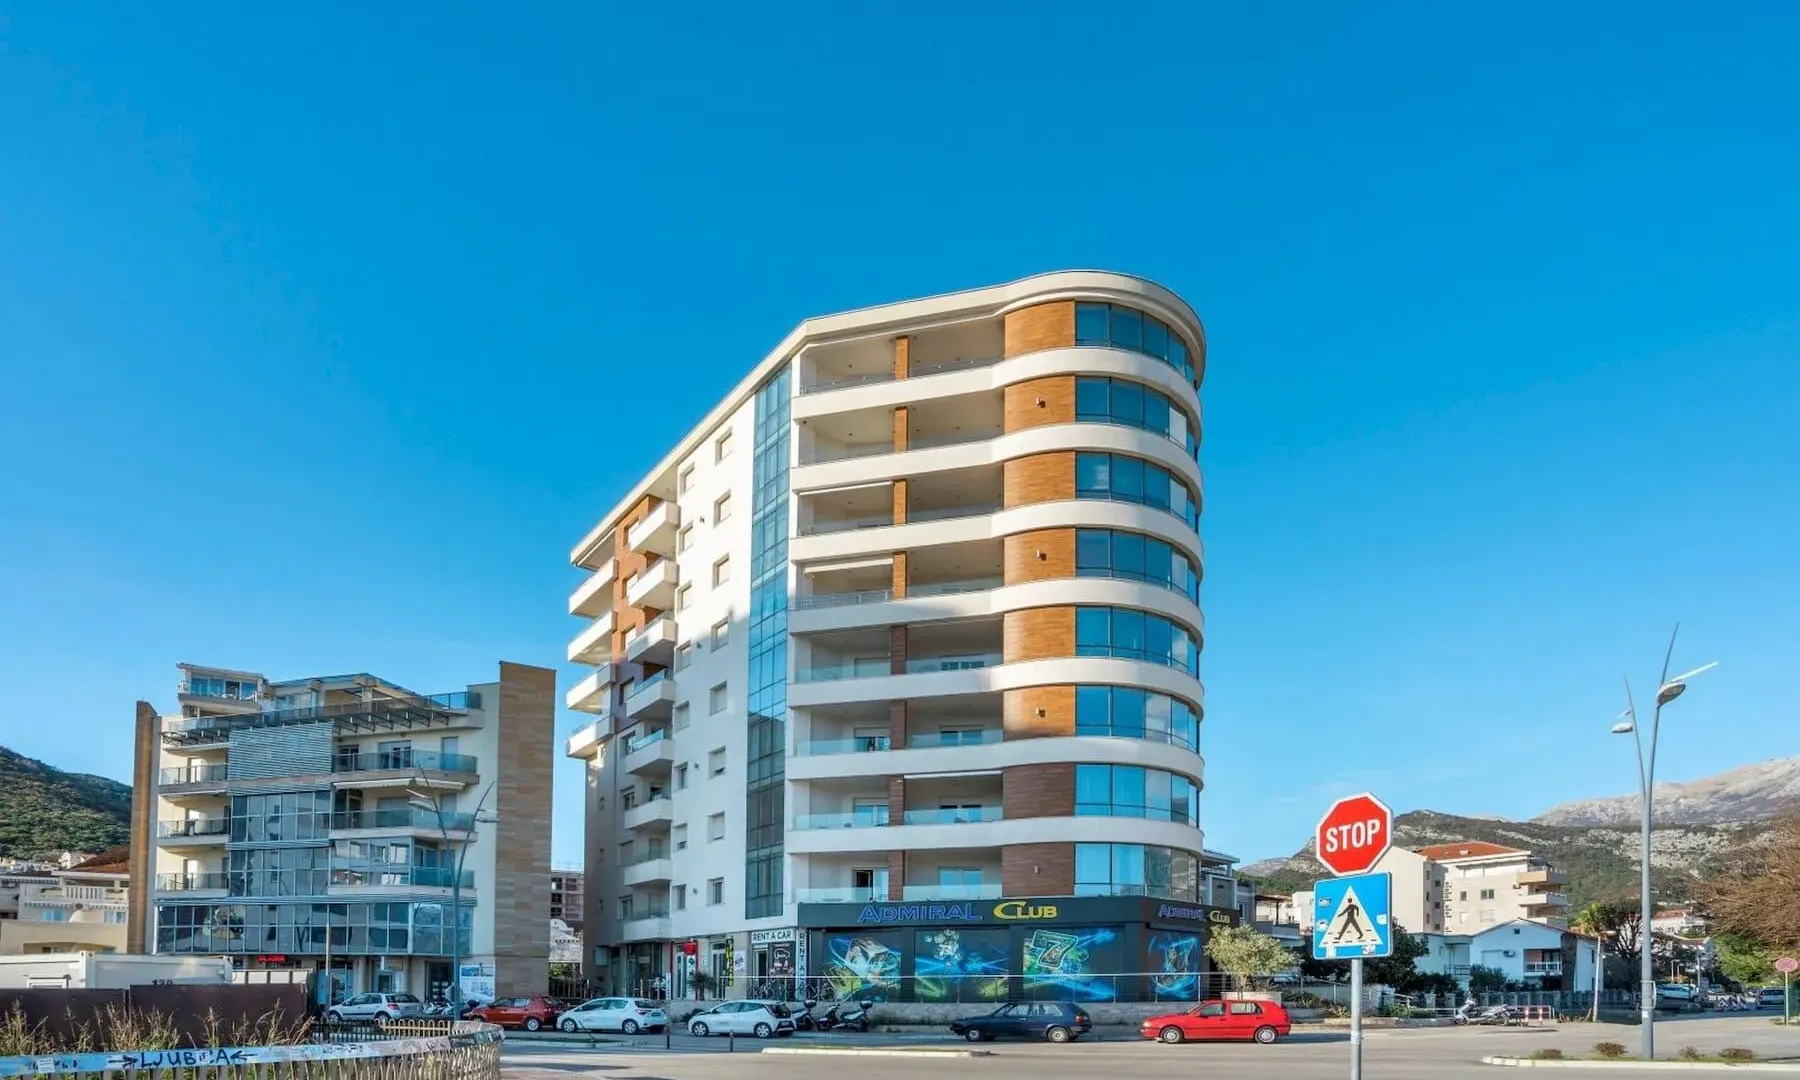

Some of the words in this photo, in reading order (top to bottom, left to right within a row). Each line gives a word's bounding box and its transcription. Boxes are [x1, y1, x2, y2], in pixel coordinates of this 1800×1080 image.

[1326, 819, 1380, 852] STOP
[857, 902, 981, 923] ADMIRAL
[993, 901, 1058, 920] CLUB
[753, 931, 770, 941] RENT
[771, 931, 777, 941] A
[777, 930, 792, 940] CAR
